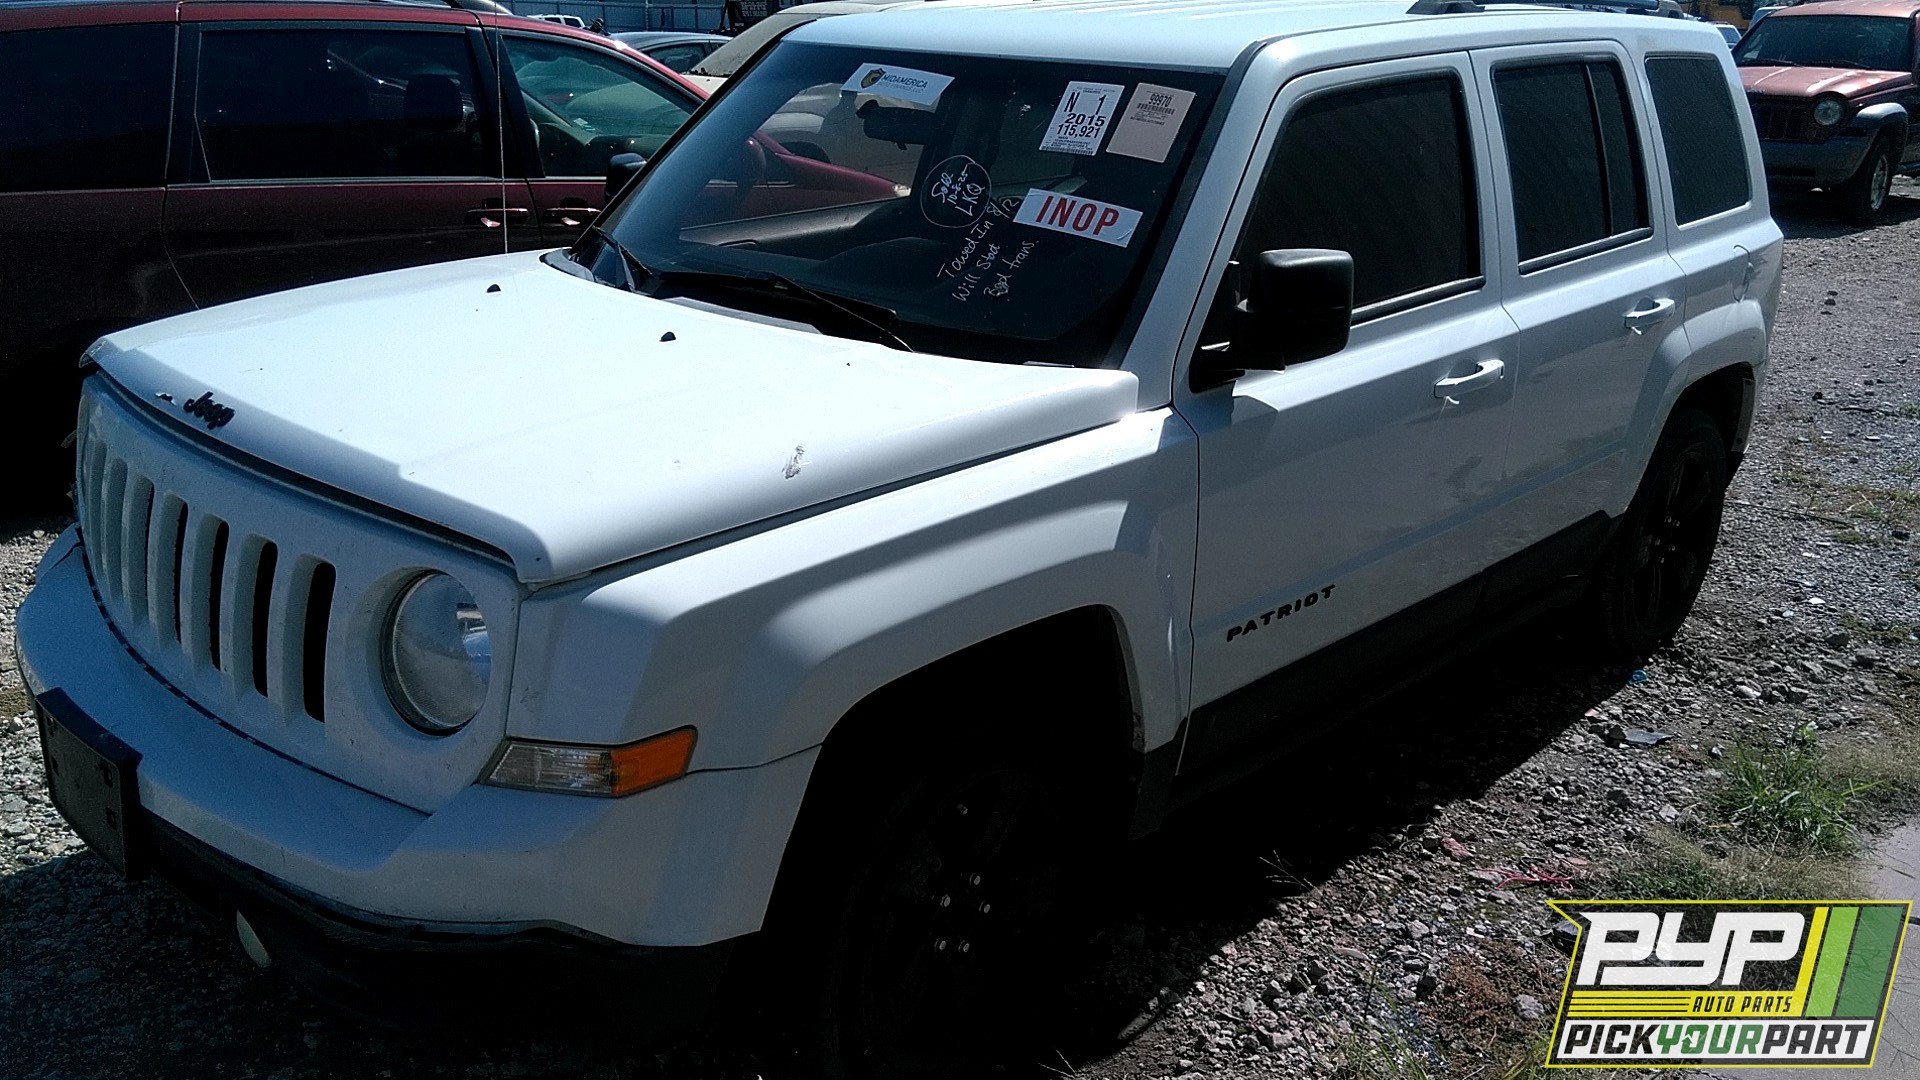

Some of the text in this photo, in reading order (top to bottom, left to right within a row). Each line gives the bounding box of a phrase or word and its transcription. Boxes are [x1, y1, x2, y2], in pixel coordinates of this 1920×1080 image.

[1057, 124, 1101, 138] 115,921
[1065, 113, 1106, 127] 2015
[954, 183, 986, 217] LKQ
[1035, 195, 1120, 236] INOP
[936, 237, 980, 278] Towed
[970, 220, 995, 239] In
[951, 273, 981, 302] Will
[183, 391, 236, 431] Jeep
[1226, 584, 1336, 643] PATRIOT
